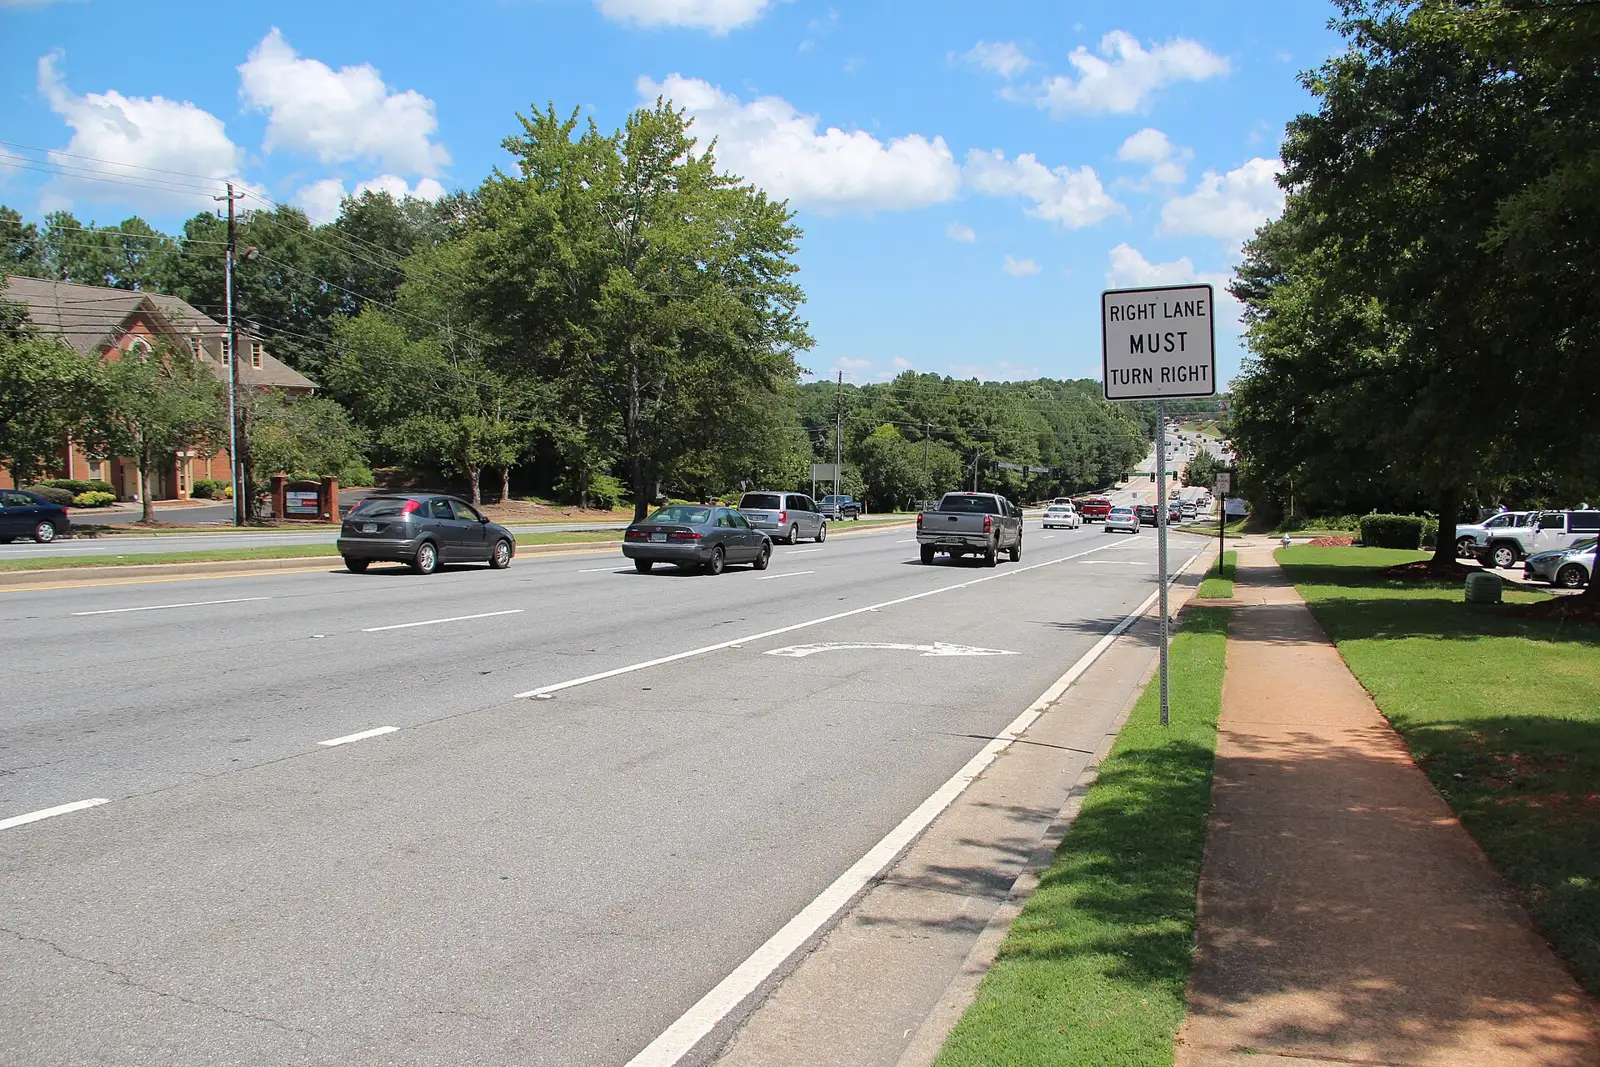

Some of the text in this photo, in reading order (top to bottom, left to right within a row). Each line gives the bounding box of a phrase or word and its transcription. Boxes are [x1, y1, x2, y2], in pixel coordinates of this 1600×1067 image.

[1110, 300, 1206, 322] RIGHT LANE
[1130, 332, 1187, 354] MUST
[1110, 365, 1208, 385] TURN RIGHT
